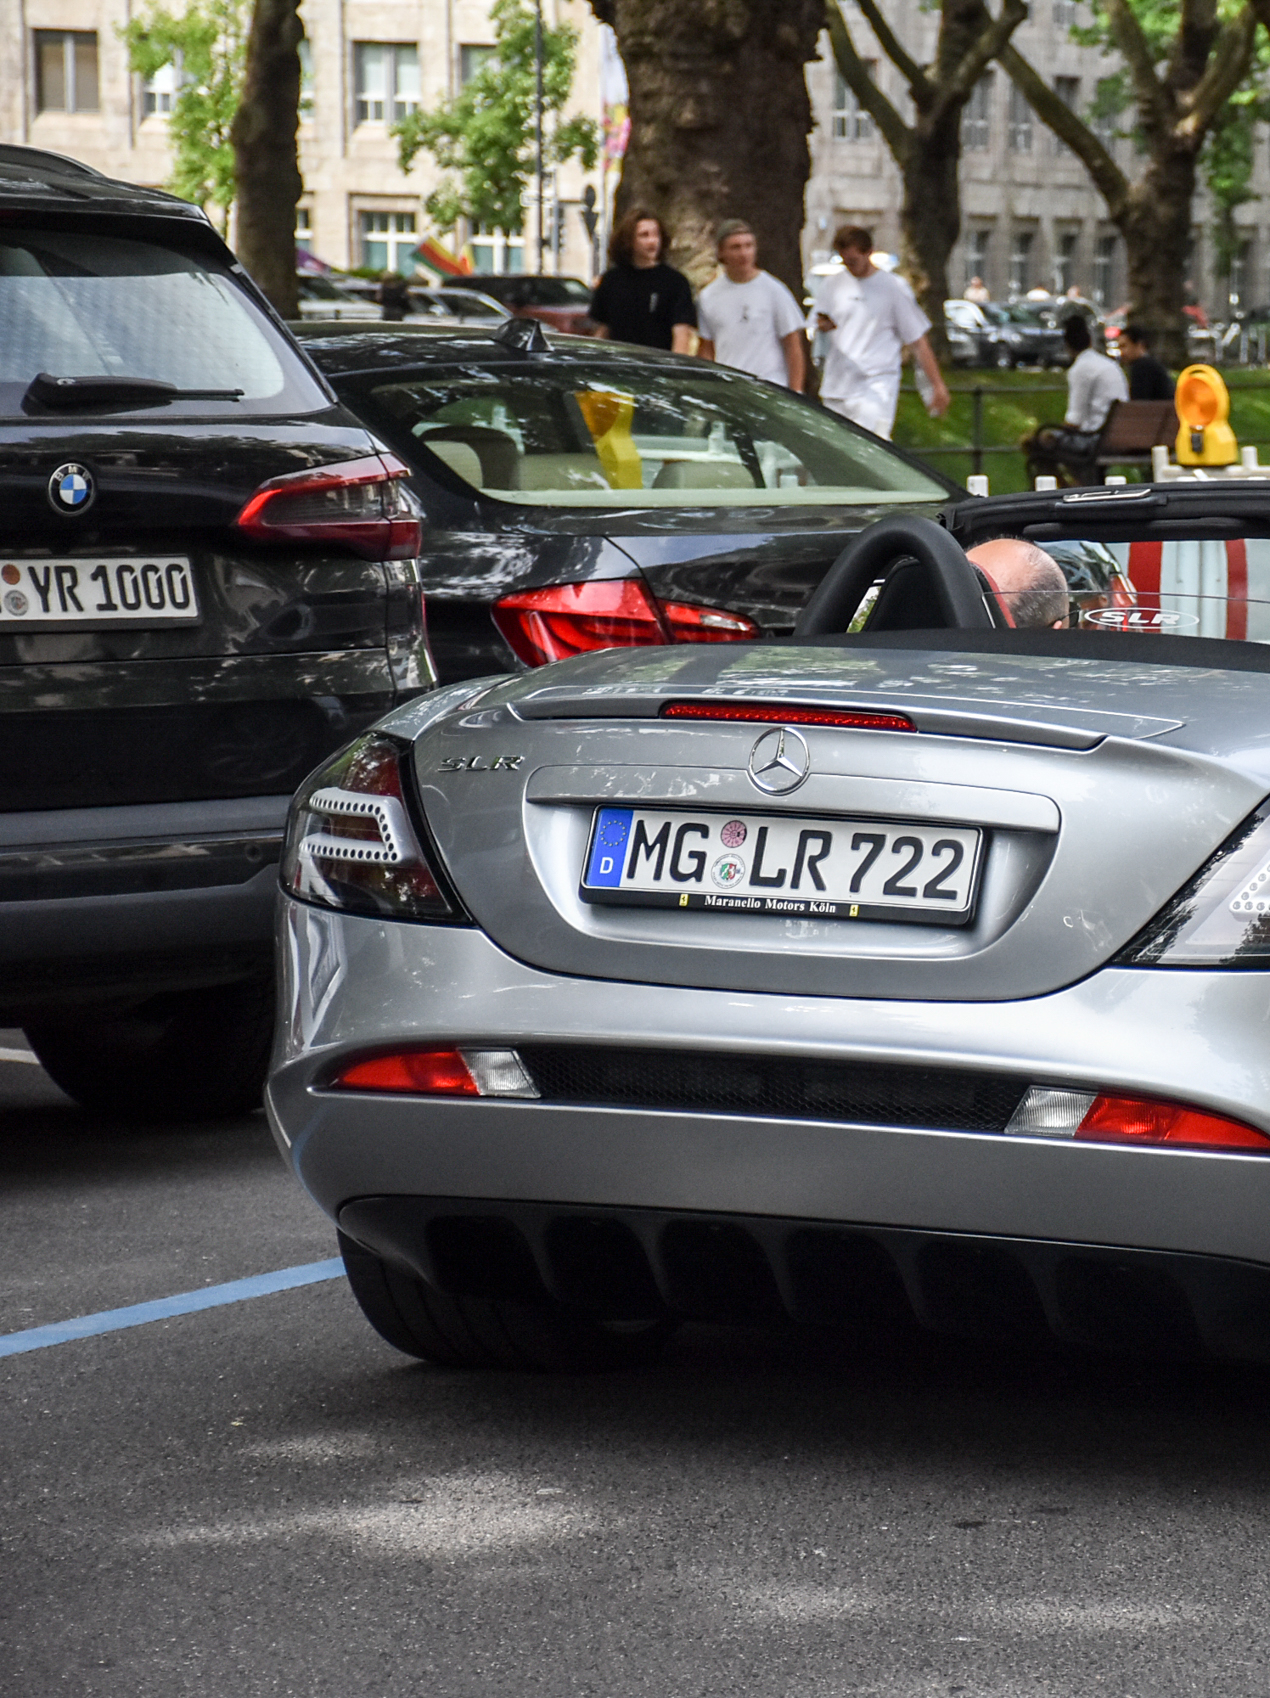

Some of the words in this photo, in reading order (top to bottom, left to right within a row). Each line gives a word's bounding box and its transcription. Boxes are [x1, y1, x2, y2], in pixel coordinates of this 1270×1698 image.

[54, 465, 91, 481] BMW
[27, 565, 84, 613] YR
[90, 563, 190, 611] 1000
[1100, 611, 1180, 625] SLR
[438, 755, 525, 772] SLR
[600, 857, 614, 874] D
[626, 819, 709, 883] MG
[748, 826, 832, 891] LR
[849, 832, 964, 900] 722
[704, 895, 761, 909] Maranello
[764, 899, 806, 911] Motors
[809, 901, 837, 914] Köln
